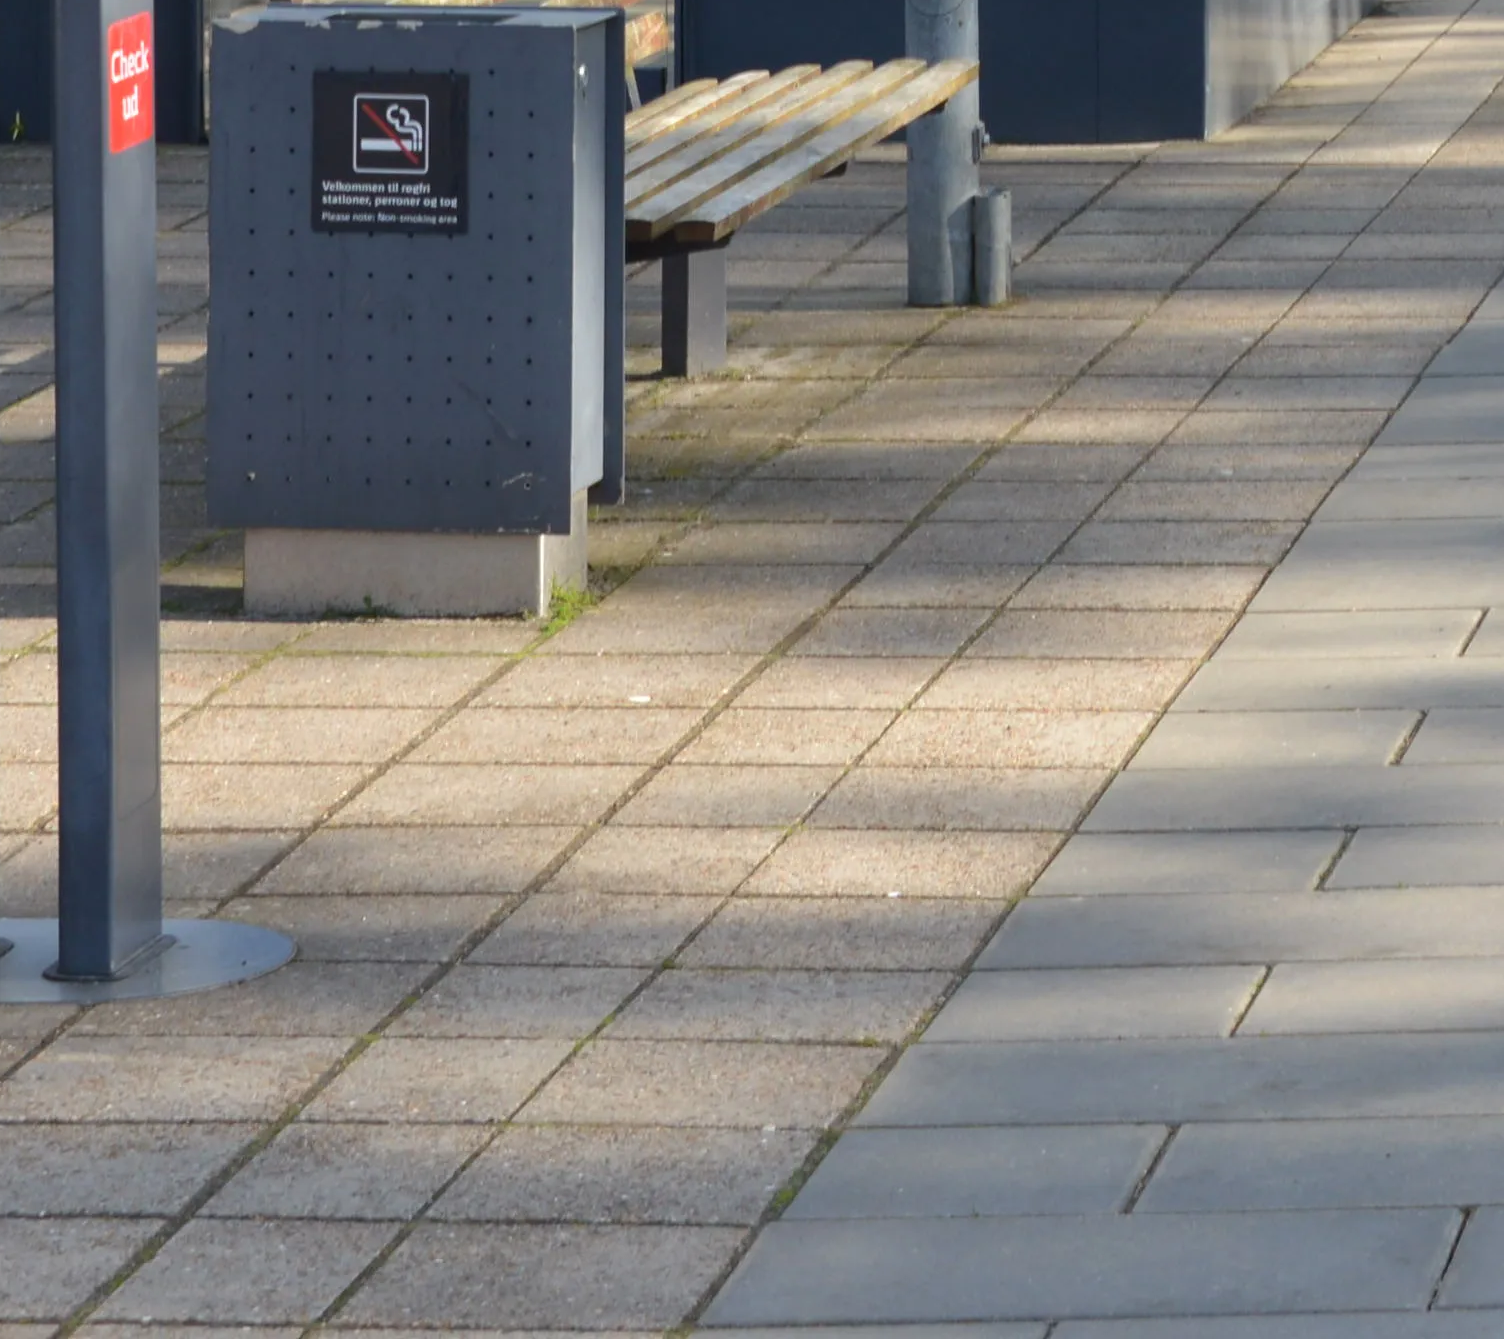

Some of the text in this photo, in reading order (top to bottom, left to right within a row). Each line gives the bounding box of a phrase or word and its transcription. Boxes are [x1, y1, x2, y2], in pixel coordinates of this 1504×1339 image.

[111, 39, 150, 84] Check
[121, 82, 139, 121] ud
[322, 180, 385, 193] Velkommen
[387, 182, 399, 193] til
[322, 194, 458, 209] stationer, perroner og tog
[321, 211, 351, 222] Please
[377, 212, 437, 225] Non-smoking
